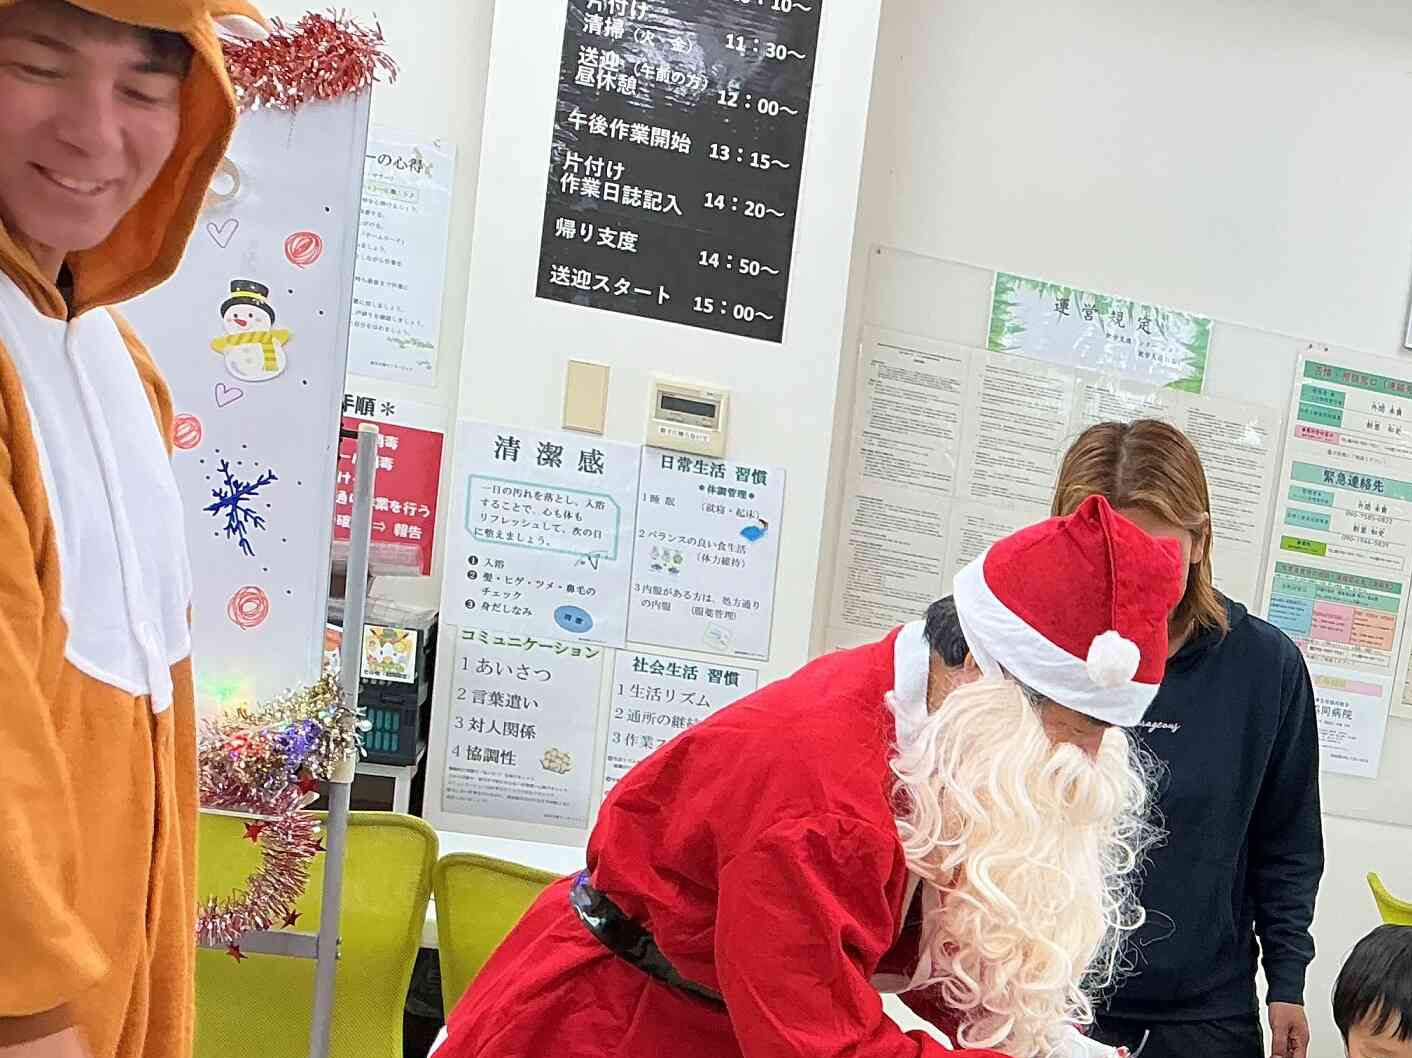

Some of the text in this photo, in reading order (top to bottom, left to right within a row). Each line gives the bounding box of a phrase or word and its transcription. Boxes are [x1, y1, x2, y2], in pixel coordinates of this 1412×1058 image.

[582, 13, 625, 40] 清掃
[578, 45, 620, 71] 送迎
[575, 66, 638, 95] 昼休憩
[568, 109, 692, 154] 午後作業開始
[563, 154, 625, 179] 片付け
[560, 172, 683, 216] 作業日誌記入
[556, 217, 639, 252] 帰り支度
[550, 264, 671, 305] 送迎スタート
[661, 454, 768, 486] 日常生活 習慣
[1323, 469, 1384, 493] 緊急連絡先
[484, 558, 505, 569] 入浴
[482, 587, 522, 600] チェック
[481, 602, 533, 617] 身だしなみ
[462, 629, 600, 659] コミュニケーション
[476, 658, 552, 682] あいさつ
[633, 656, 740, 687] 社会生活 習慣
[456, 688, 539, 710] 2 言葉遣い
[630, 684, 711, 707] 生活リズム
[615, 707, 624, 719] 2
[454, 716, 537, 740] 3 対人関係
[451, 745, 517, 766] 4 協調性
